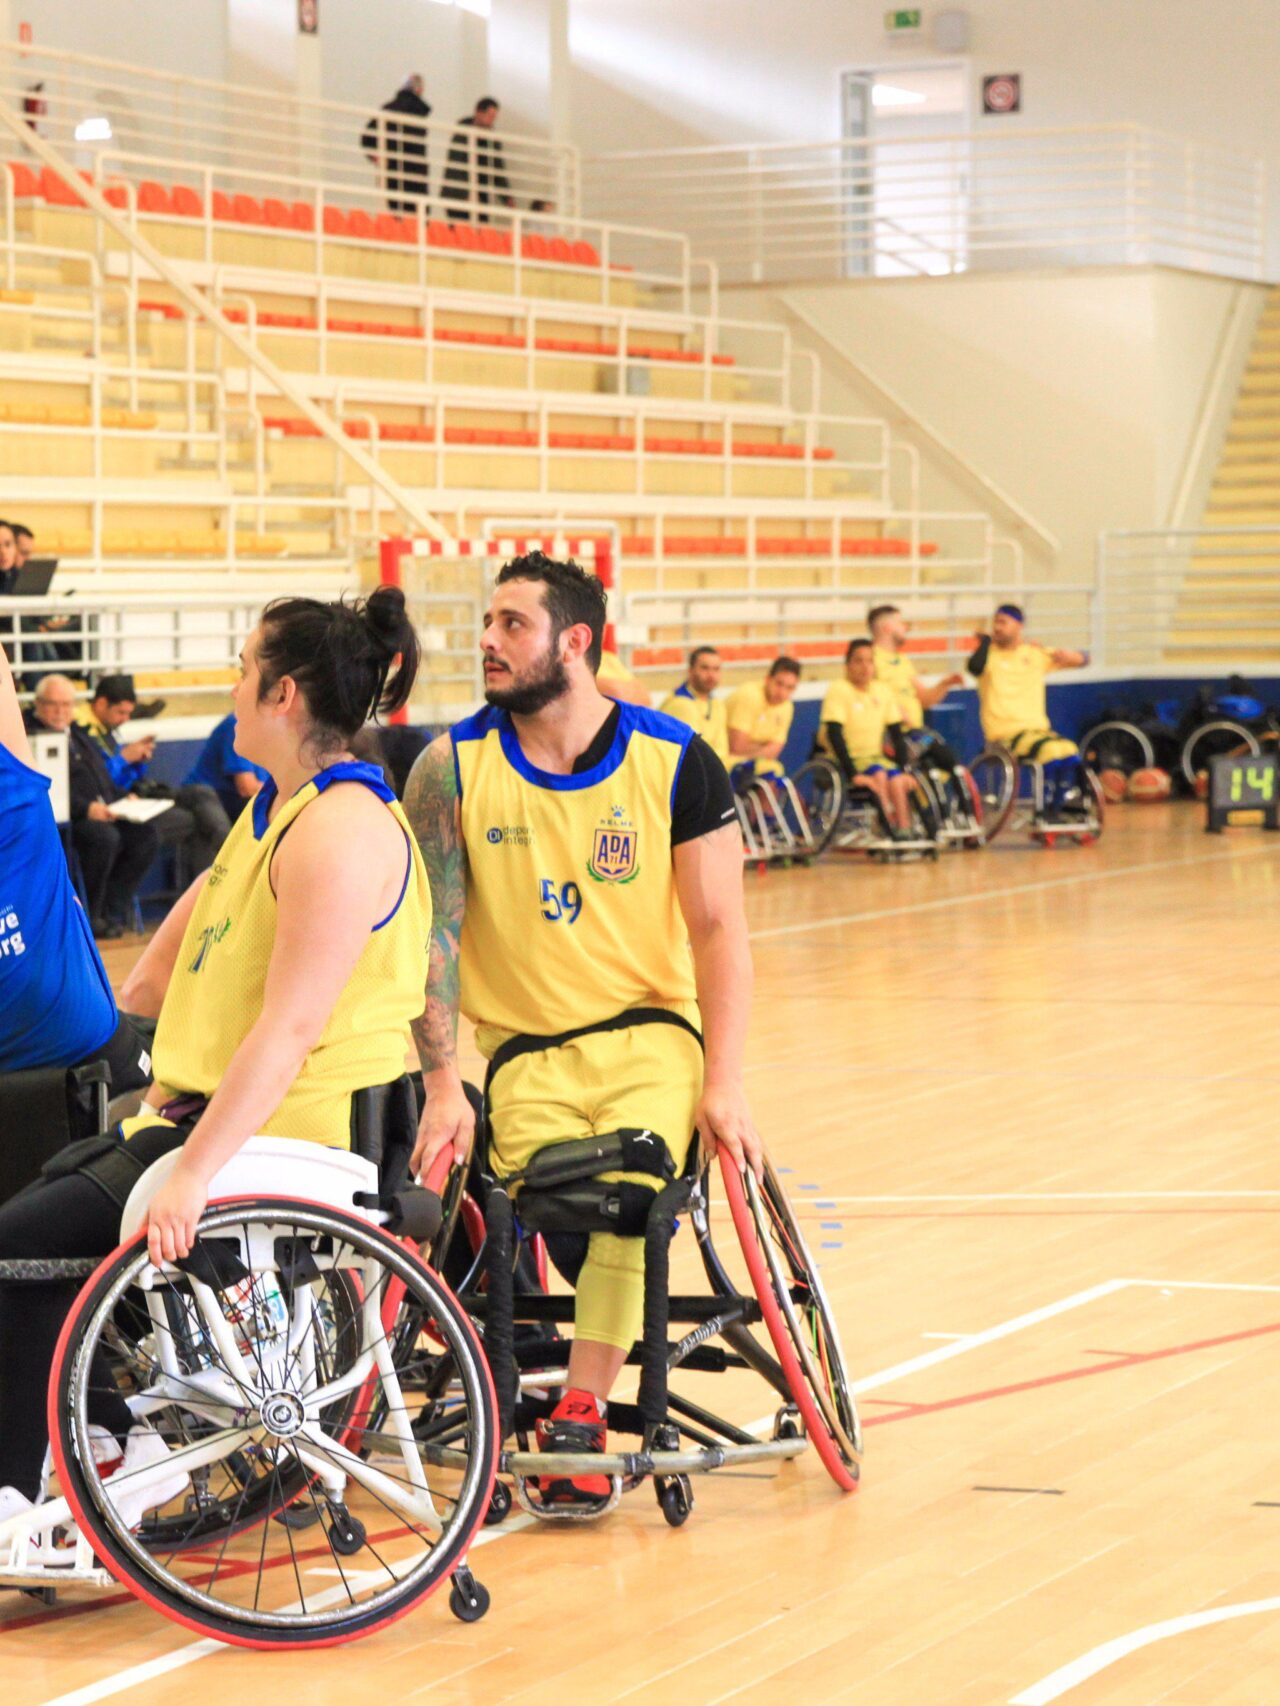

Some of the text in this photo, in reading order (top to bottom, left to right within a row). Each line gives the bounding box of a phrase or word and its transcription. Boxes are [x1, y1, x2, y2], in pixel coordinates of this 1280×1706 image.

[1230, 766, 1275, 802] 14
[596, 834, 631, 865] ADA
[539, 878, 583, 925] 59
